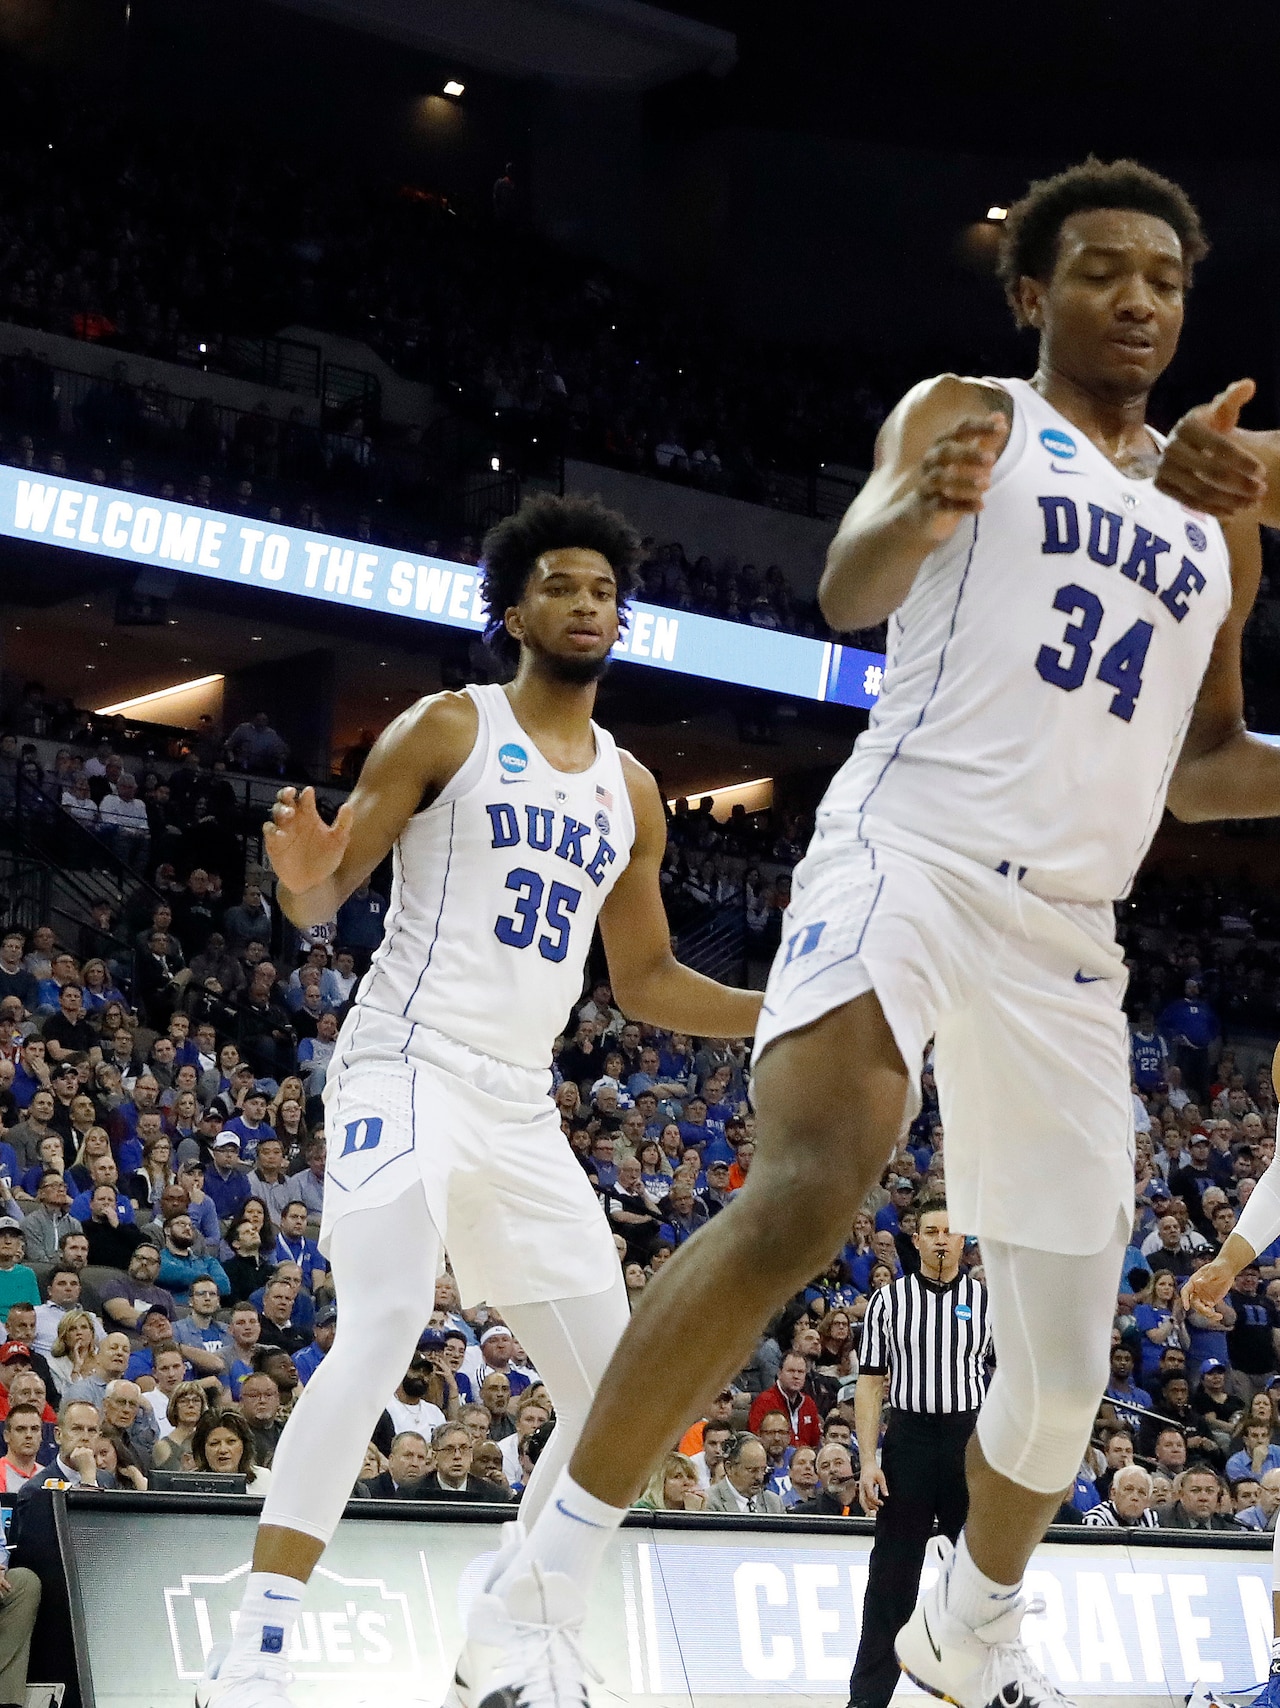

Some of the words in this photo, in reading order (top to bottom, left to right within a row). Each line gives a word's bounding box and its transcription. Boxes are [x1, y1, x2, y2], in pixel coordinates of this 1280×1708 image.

[14, 480, 227, 569] WELCOME
[239, 527, 290, 581] TO
[304, 541, 378, 600] THE
[387, 561, 490, 623] SWEE
[1037, 496, 1207, 623] DUKE
[1035, 583, 1154, 724] 34
[501, 754, 527, 768] NCAA
[486, 803, 616, 887] DUKE
[494, 867, 582, 963] 35
[1140, 1057, 1158, 1071] 22
